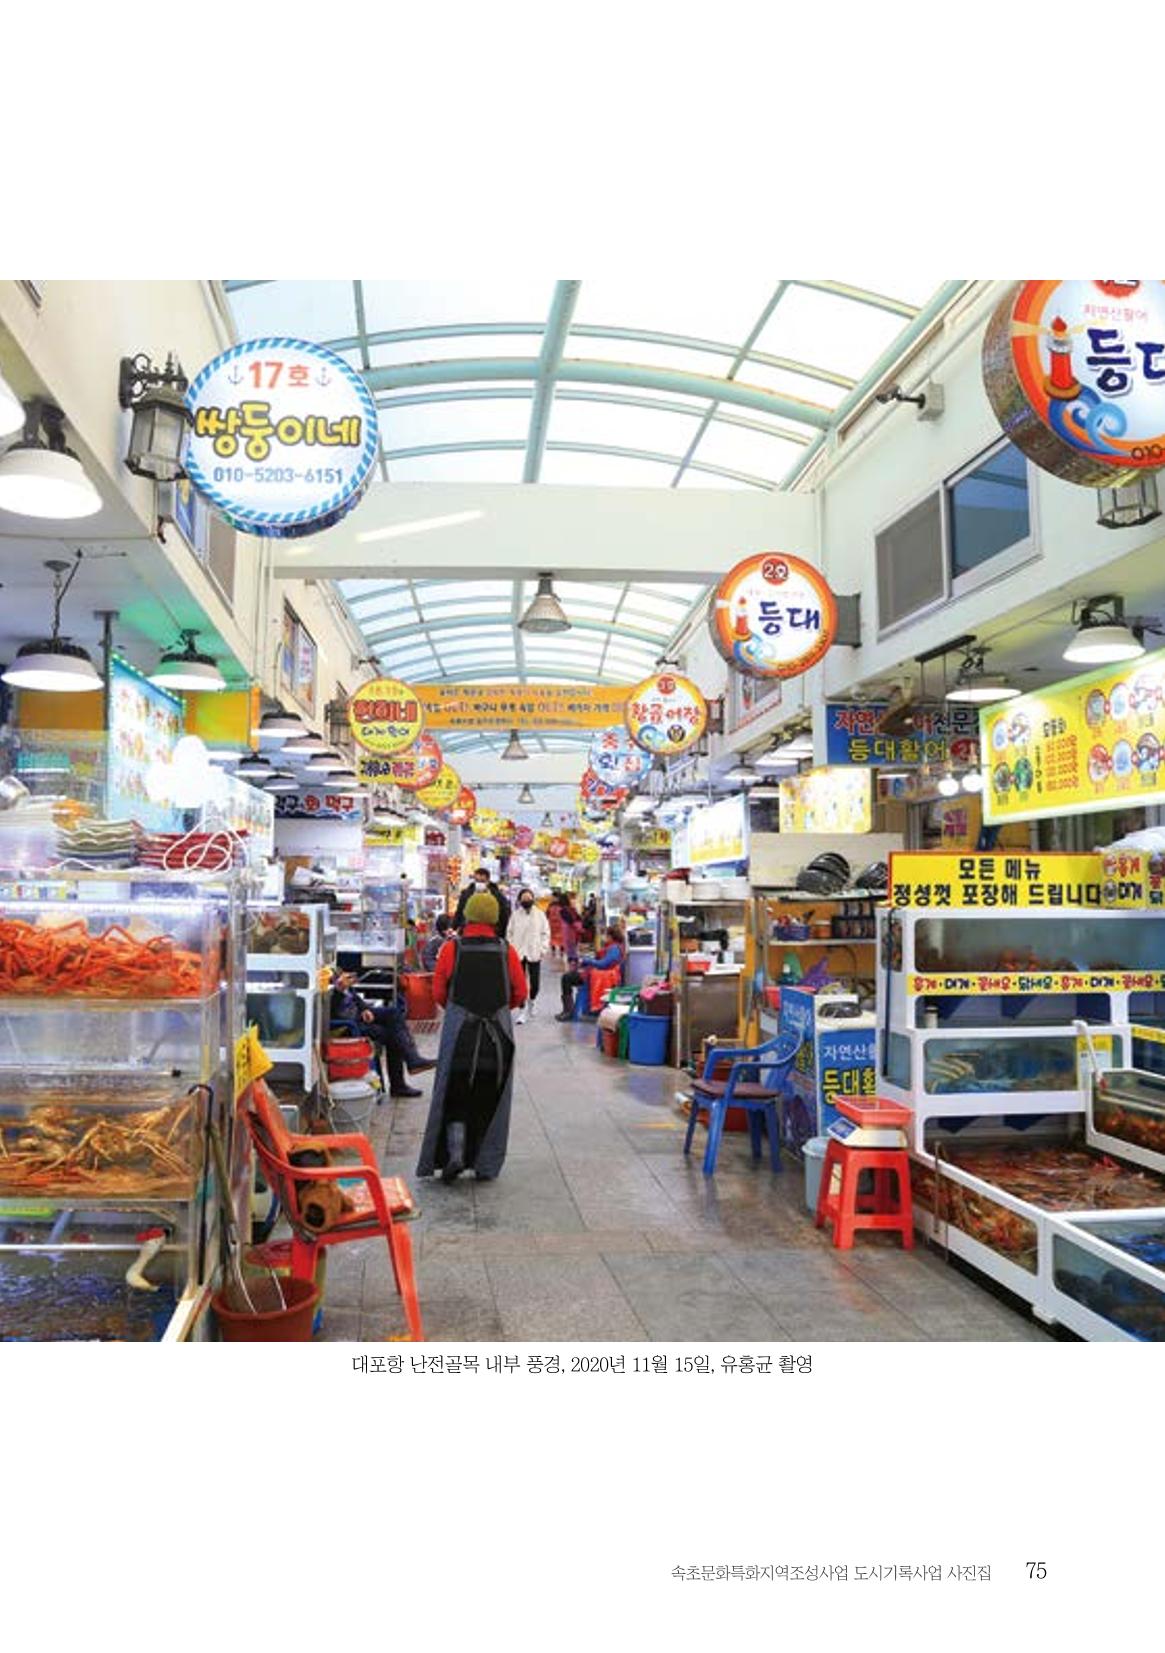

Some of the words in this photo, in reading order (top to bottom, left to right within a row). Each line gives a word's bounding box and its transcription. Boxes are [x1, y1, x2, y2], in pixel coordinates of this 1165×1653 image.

[249, 361, 309, 388] 17호
[195, 401, 361, 461] 쌍둥이네
[213, 467, 343, 484] 010-5203-6151
[758, 601, 820, 635] 등대
[848, 738, 946, 762] 등대활어
[959, 858, 995, 880] 모든
[1005, 858, 1041, 880] 메뉴
[894, 884, 950, 906] 정성껏
[962, 884, 1018, 906] 포장해
[1028, 884, 1101, 906] 드립니다
[944, 977, 969, 989] 대게
[1090, 976, 1114, 988] 대게
